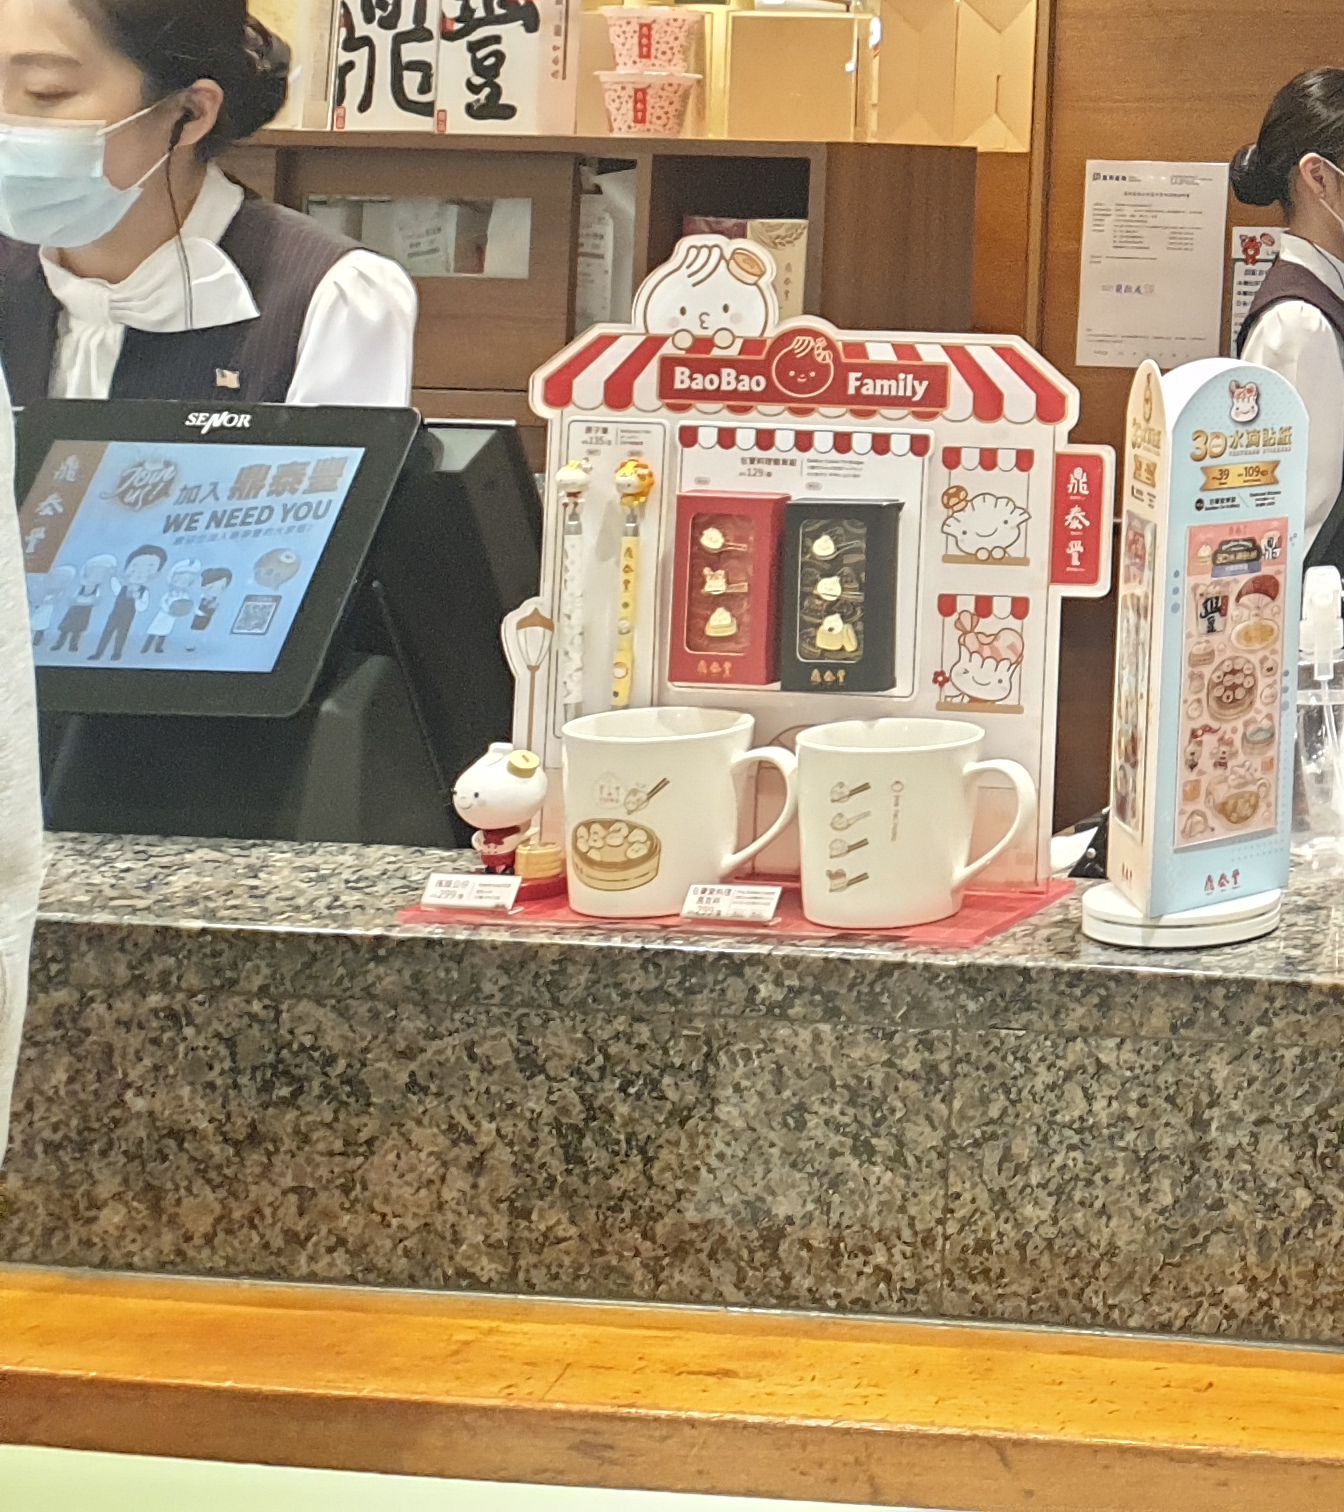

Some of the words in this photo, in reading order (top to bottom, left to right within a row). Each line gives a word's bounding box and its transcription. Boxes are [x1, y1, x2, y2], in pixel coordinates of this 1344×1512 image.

[673, 366, 767, 393] BaoBao
[847, 371, 929, 402] Family
[185, 410, 252, 434] SENOR
[162, 511, 204, 535] WE
[204, 504, 275, 530] NEED
[280, 499, 333, 524] YOU
